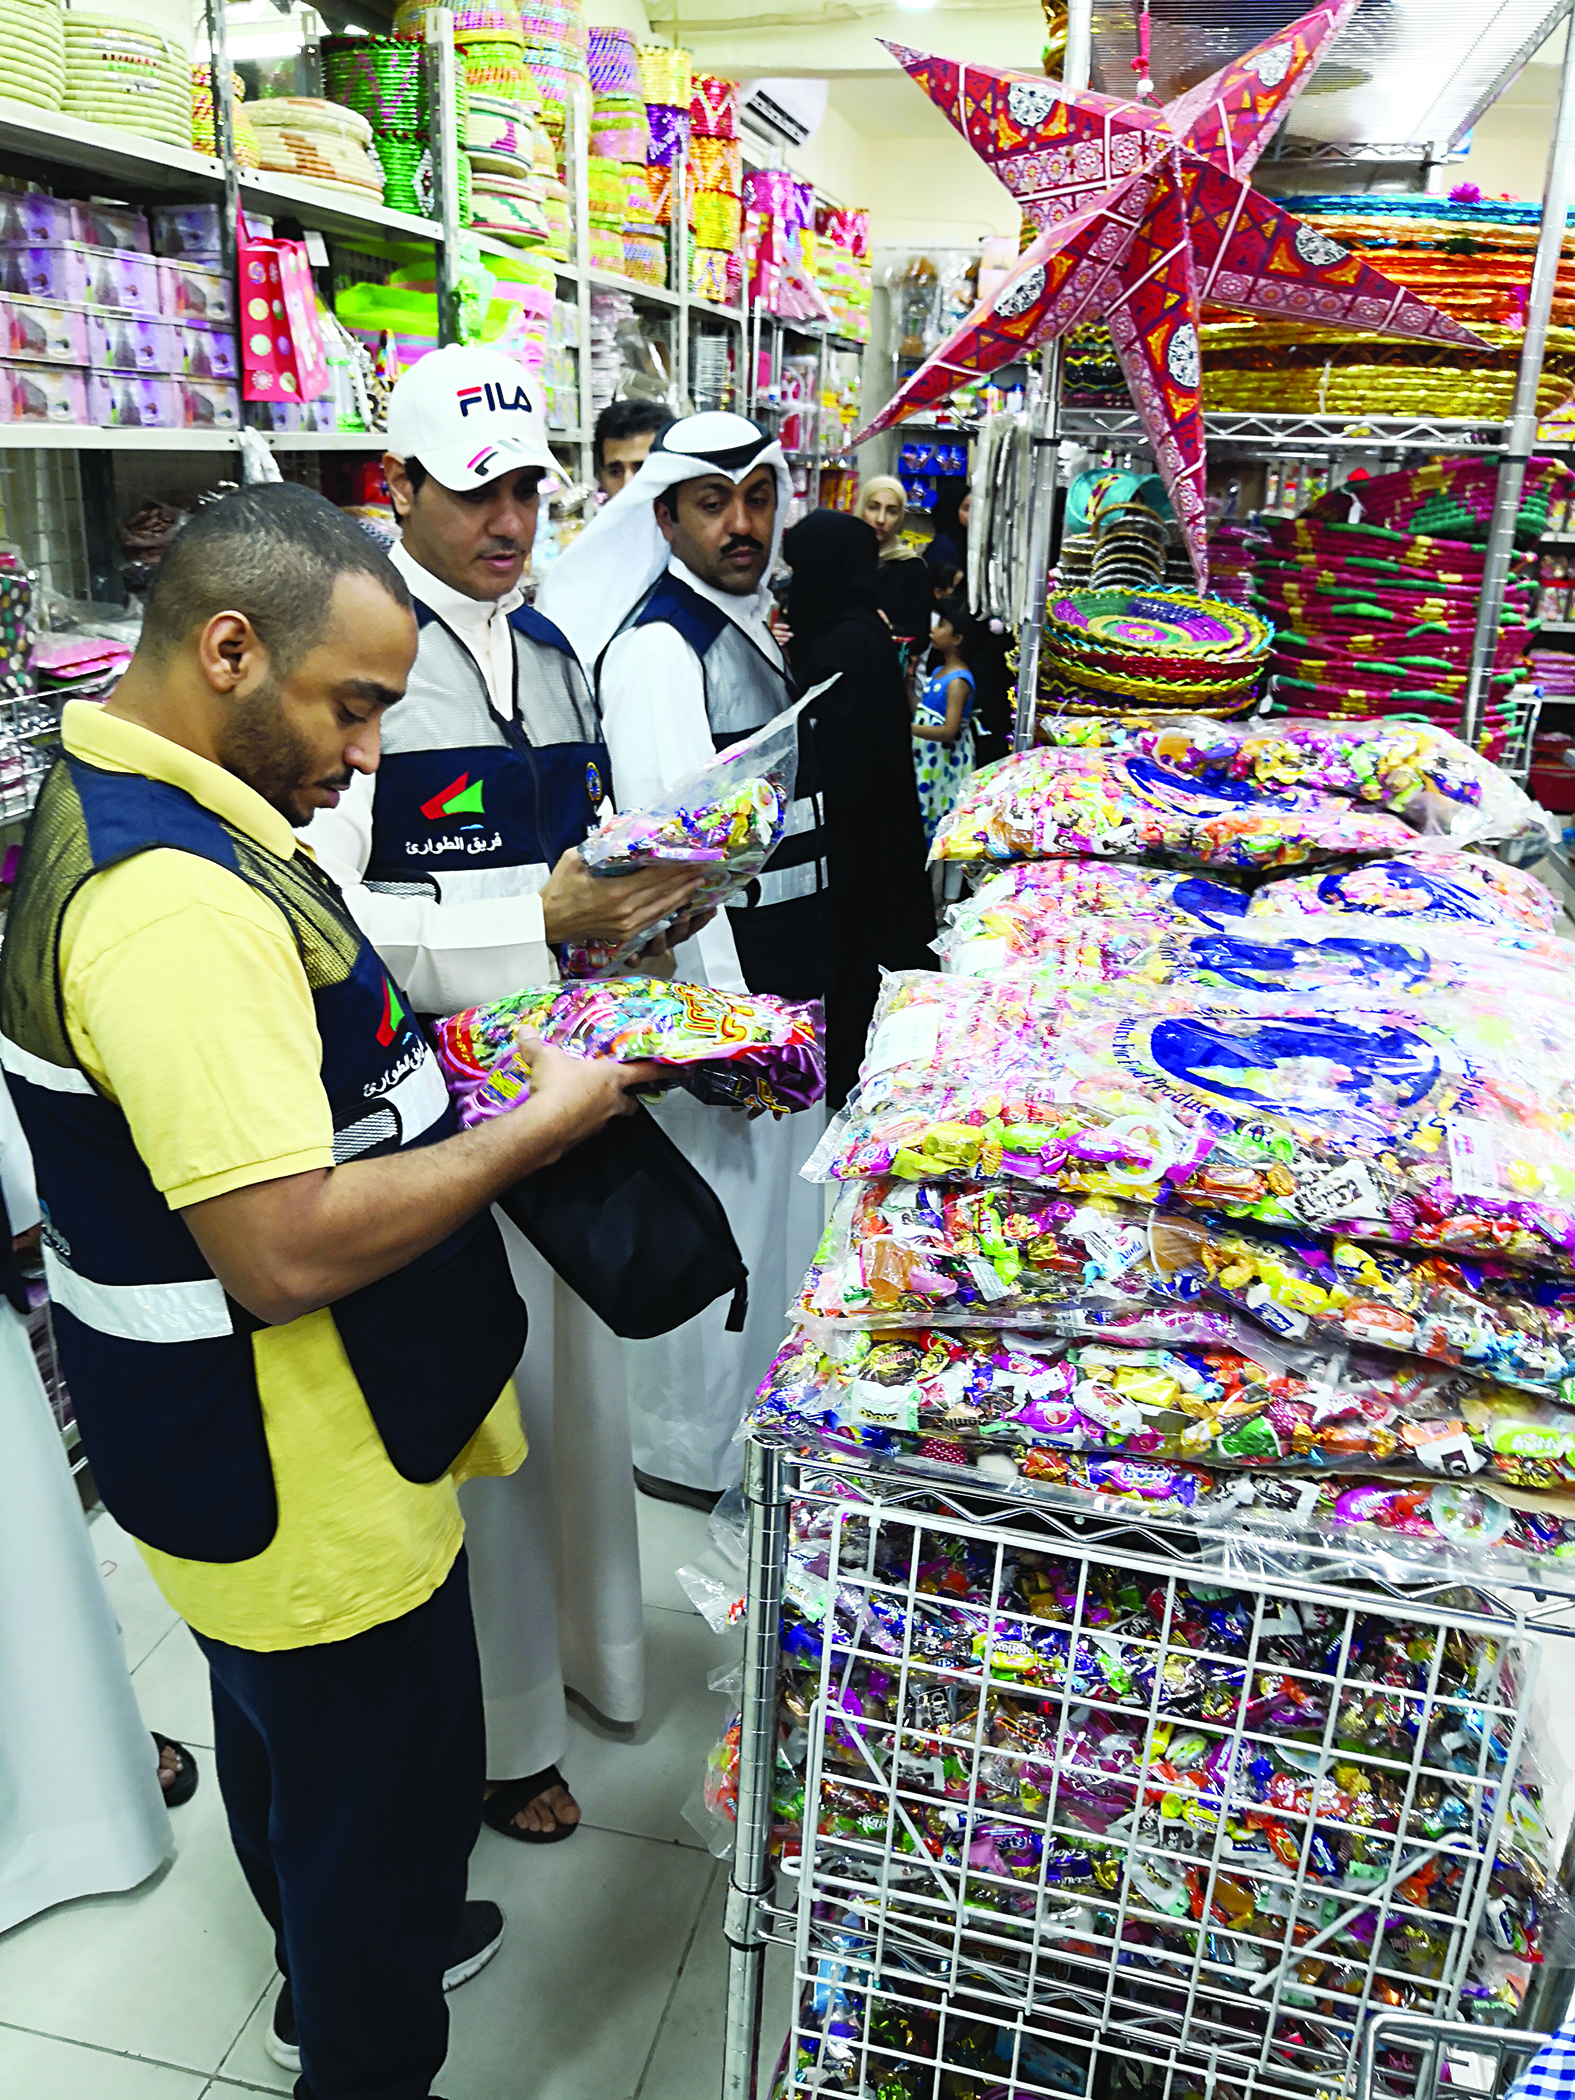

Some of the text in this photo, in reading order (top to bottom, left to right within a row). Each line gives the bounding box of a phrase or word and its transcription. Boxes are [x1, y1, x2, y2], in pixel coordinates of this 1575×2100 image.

[456, 382, 533, 417] FILA
[405, 832, 503, 855] فريق الطوارئ
